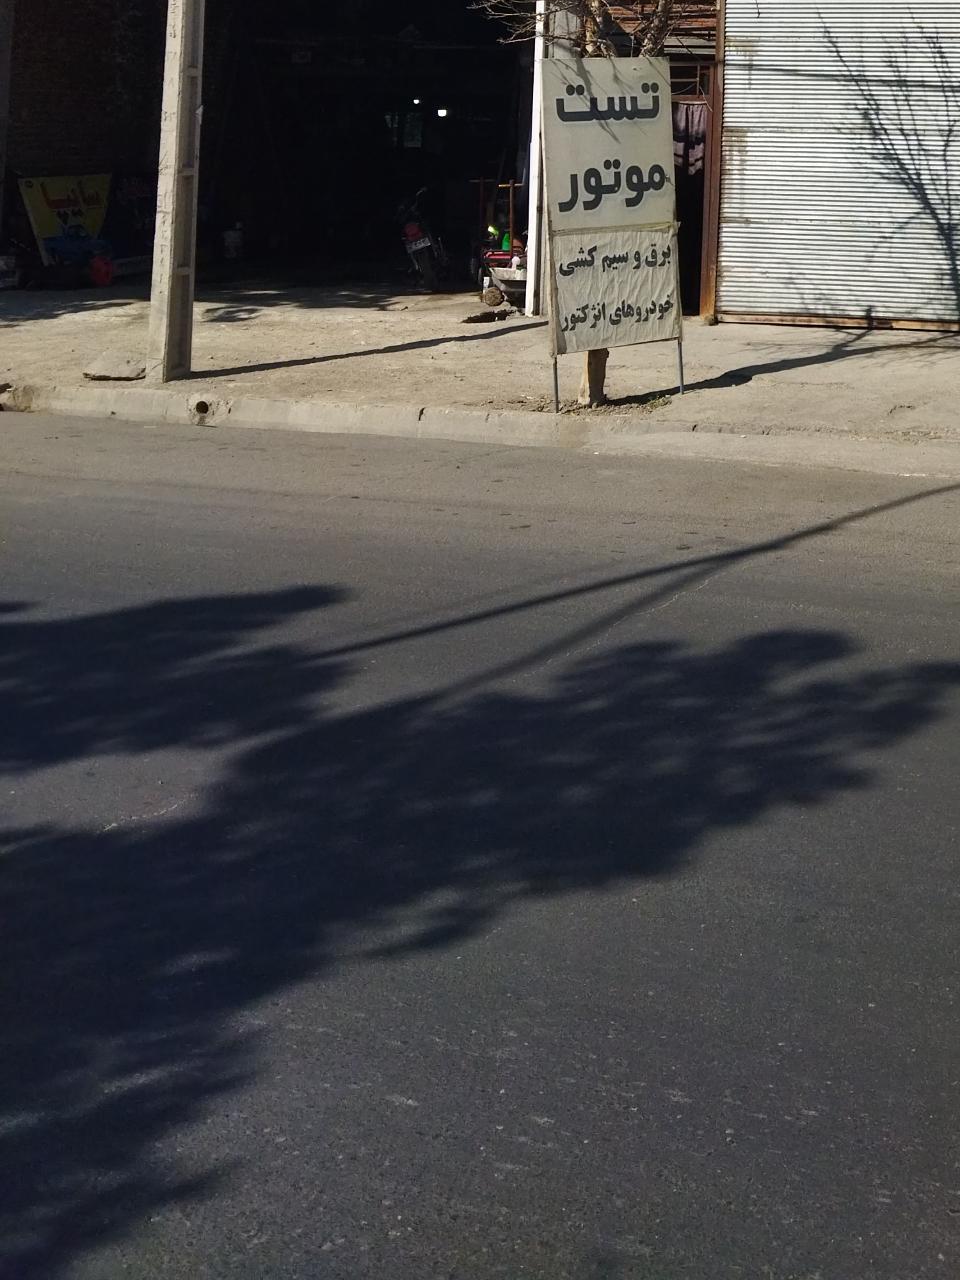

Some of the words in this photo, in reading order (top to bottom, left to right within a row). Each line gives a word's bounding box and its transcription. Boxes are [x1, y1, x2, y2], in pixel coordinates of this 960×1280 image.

[556, 82, 660, 122] تست
[558, 158, 666, 213] موتور
[559, 245, 598, 276] کشی
[601, 252, 629, 272] سیم
[632, 250, 641, 270] و
[645, 243, 671, 268] برق
[609, 294, 674, 325] خودروهای
